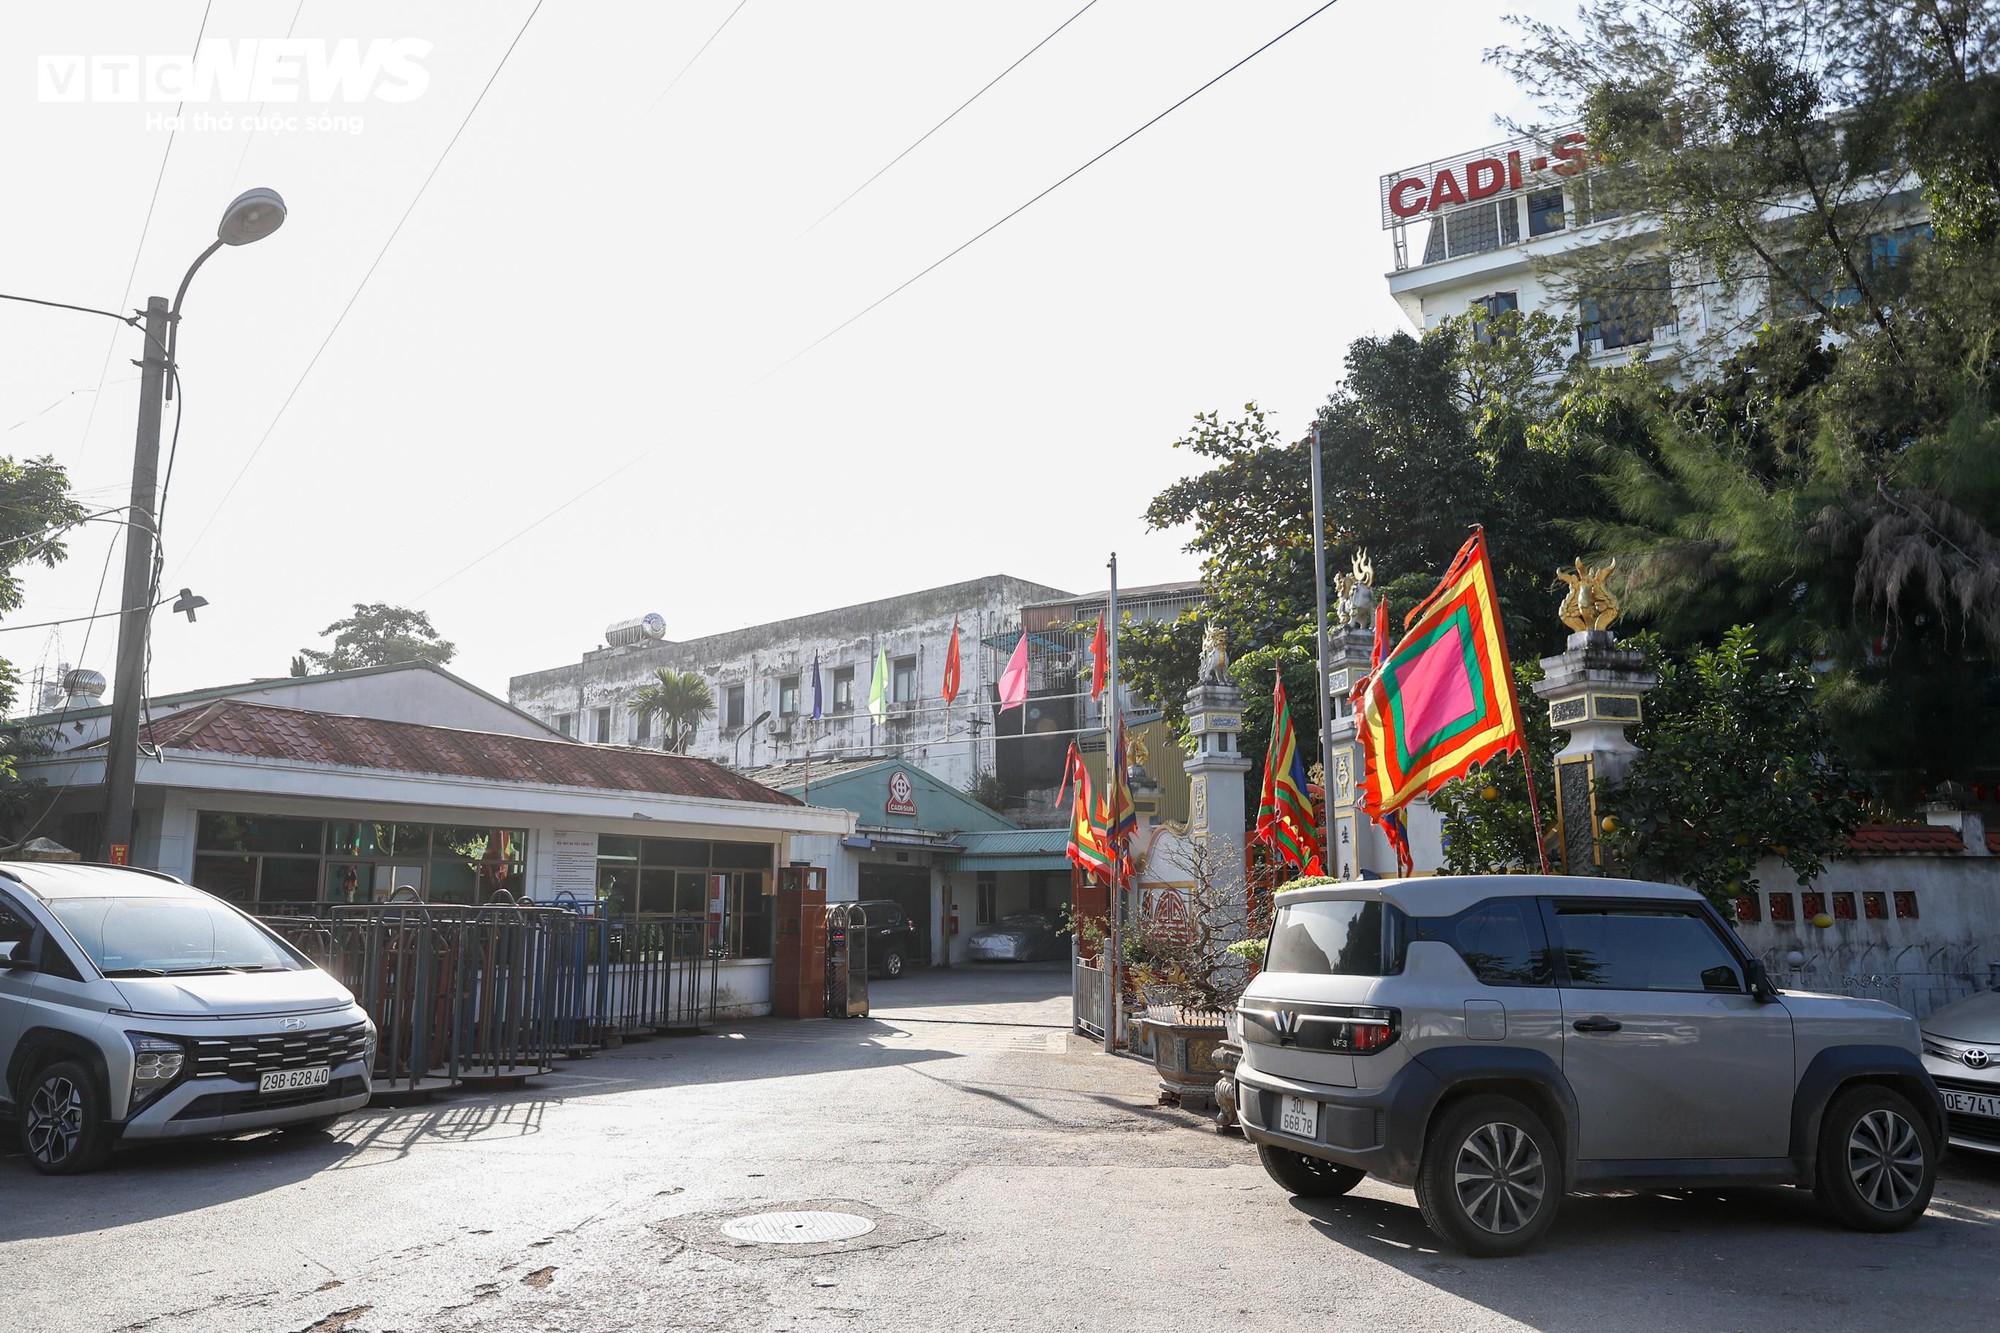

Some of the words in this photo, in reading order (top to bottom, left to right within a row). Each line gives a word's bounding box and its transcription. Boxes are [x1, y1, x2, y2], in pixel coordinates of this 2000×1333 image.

[1388, 115, 1650, 219] CADI-S
[1332, 1039, 1348, 1048] VF3
[262, 1068, 329, 1091] 29B-628.40
[1291, 1095, 1306, 1115] 30L
[1940, 1092, 2000, 1116] 0E-741.
[1284, 1114, 1313, 1134] 668.78
